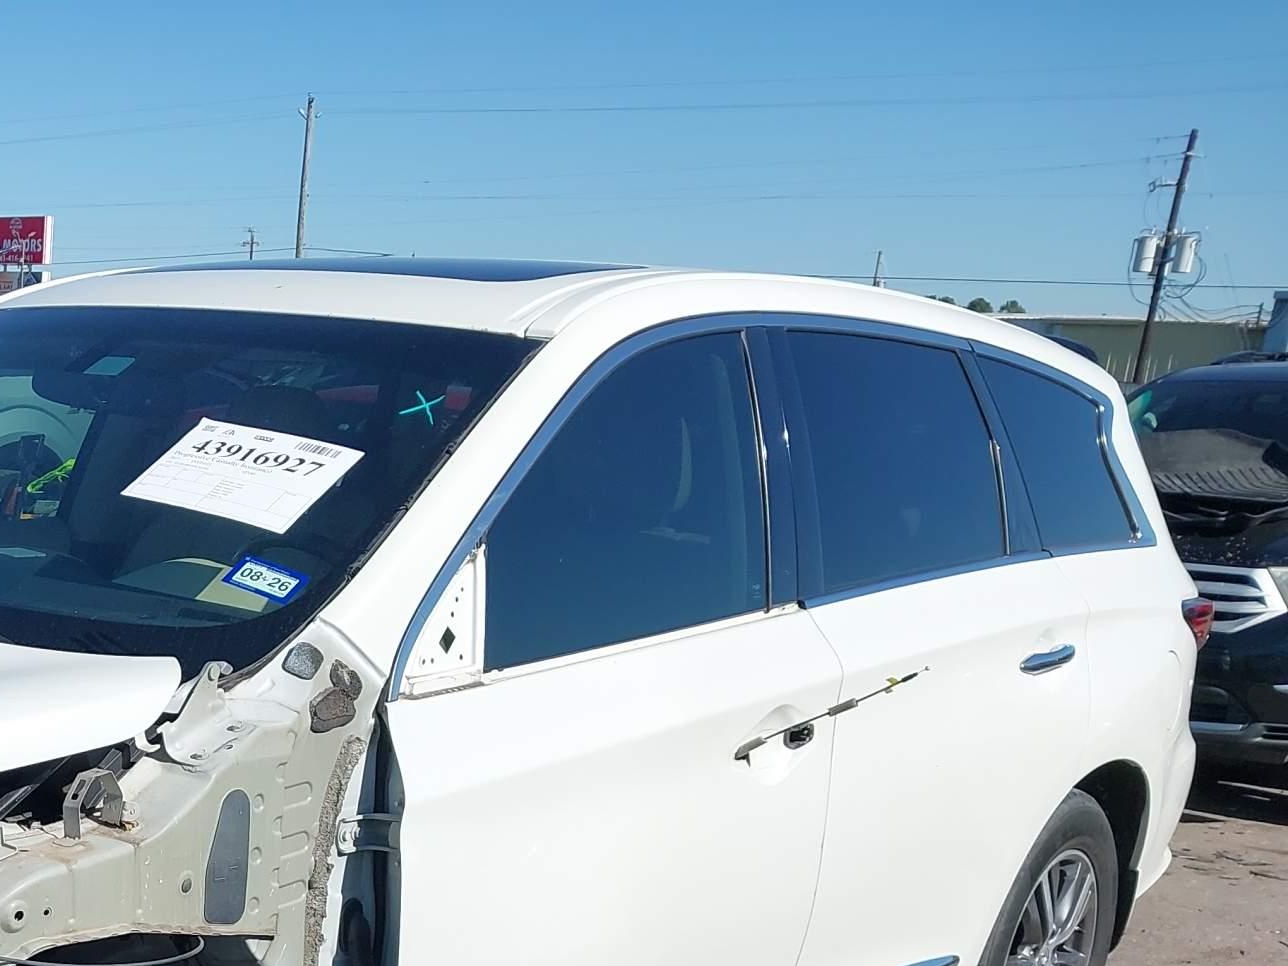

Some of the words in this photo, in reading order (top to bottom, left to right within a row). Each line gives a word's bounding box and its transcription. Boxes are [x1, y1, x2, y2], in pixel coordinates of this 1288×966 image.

[192, 439, 325, 476] 43916927
[240, 567, 263, 581] 08
[266, 577, 292, 592] 26
